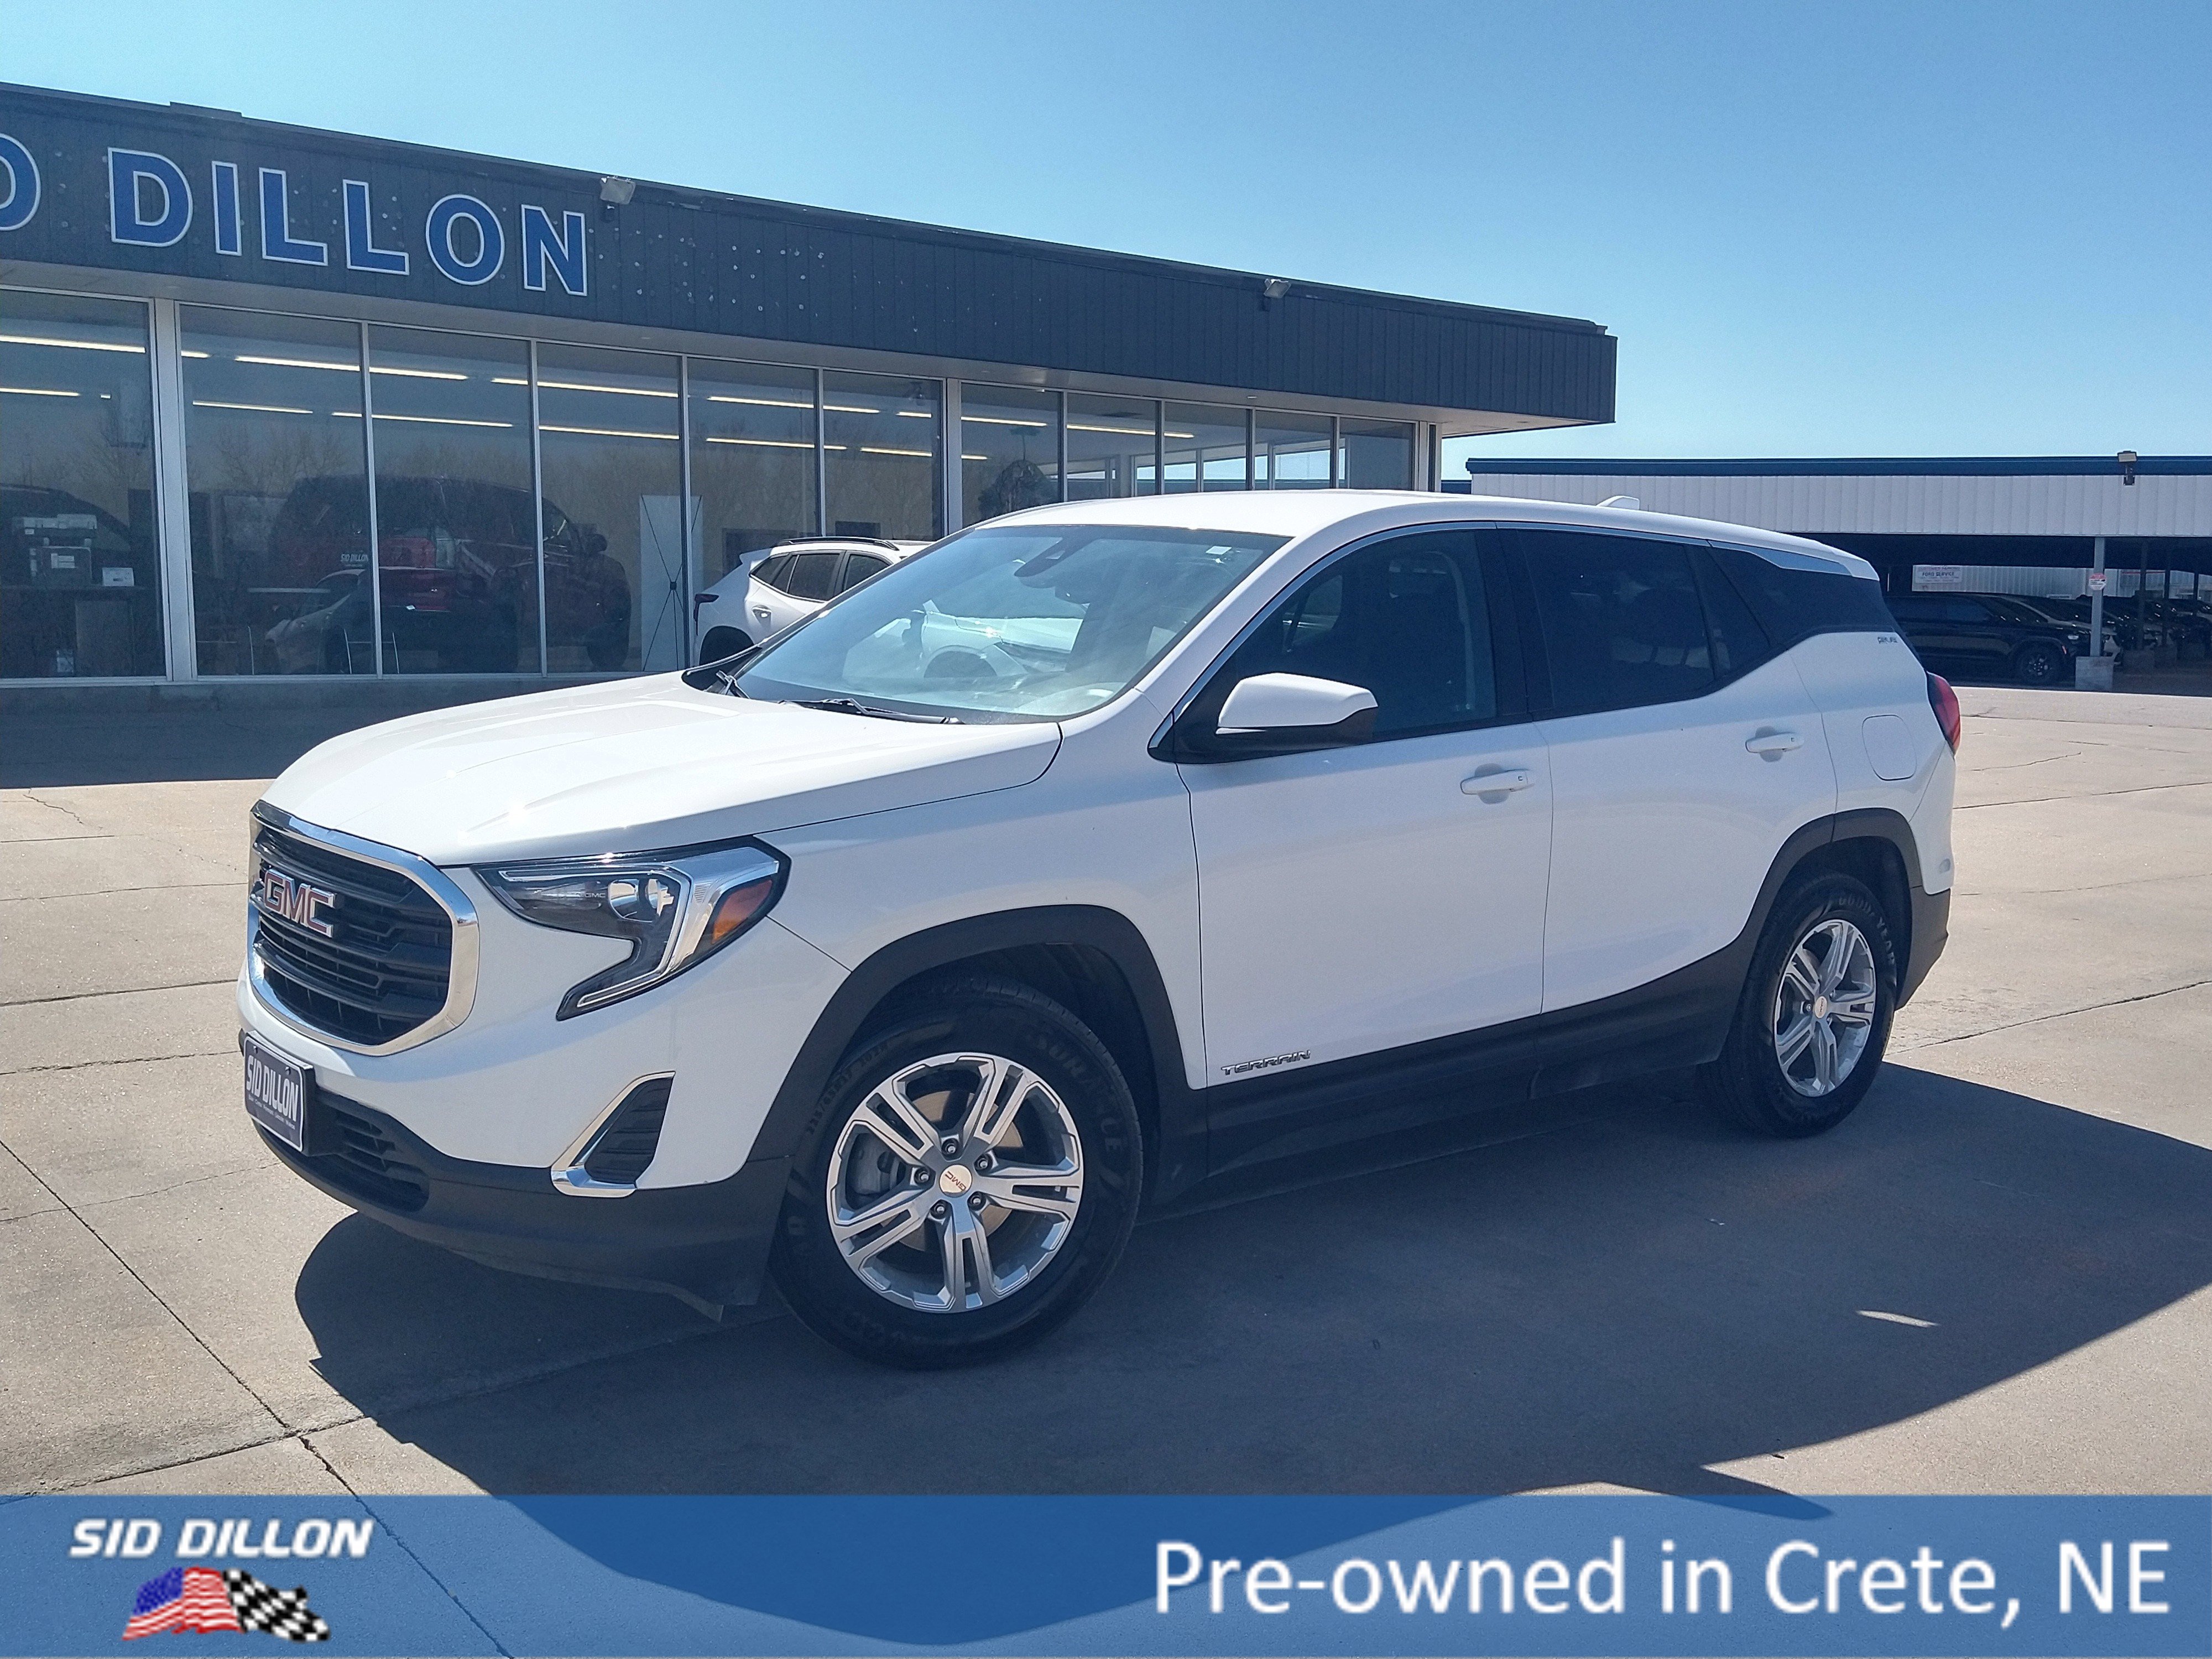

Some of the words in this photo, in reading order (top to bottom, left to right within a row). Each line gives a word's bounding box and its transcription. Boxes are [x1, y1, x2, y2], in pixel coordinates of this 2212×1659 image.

[107, 147, 588, 296] DILLON
[264, 868, 336, 938] GMC
[246, 1055, 262, 1098] SID
[262, 1065, 299, 1122] DILLON
[1220, 1050, 1311, 1076] TERRAIN
[945, 1170, 967, 1192] GMC
